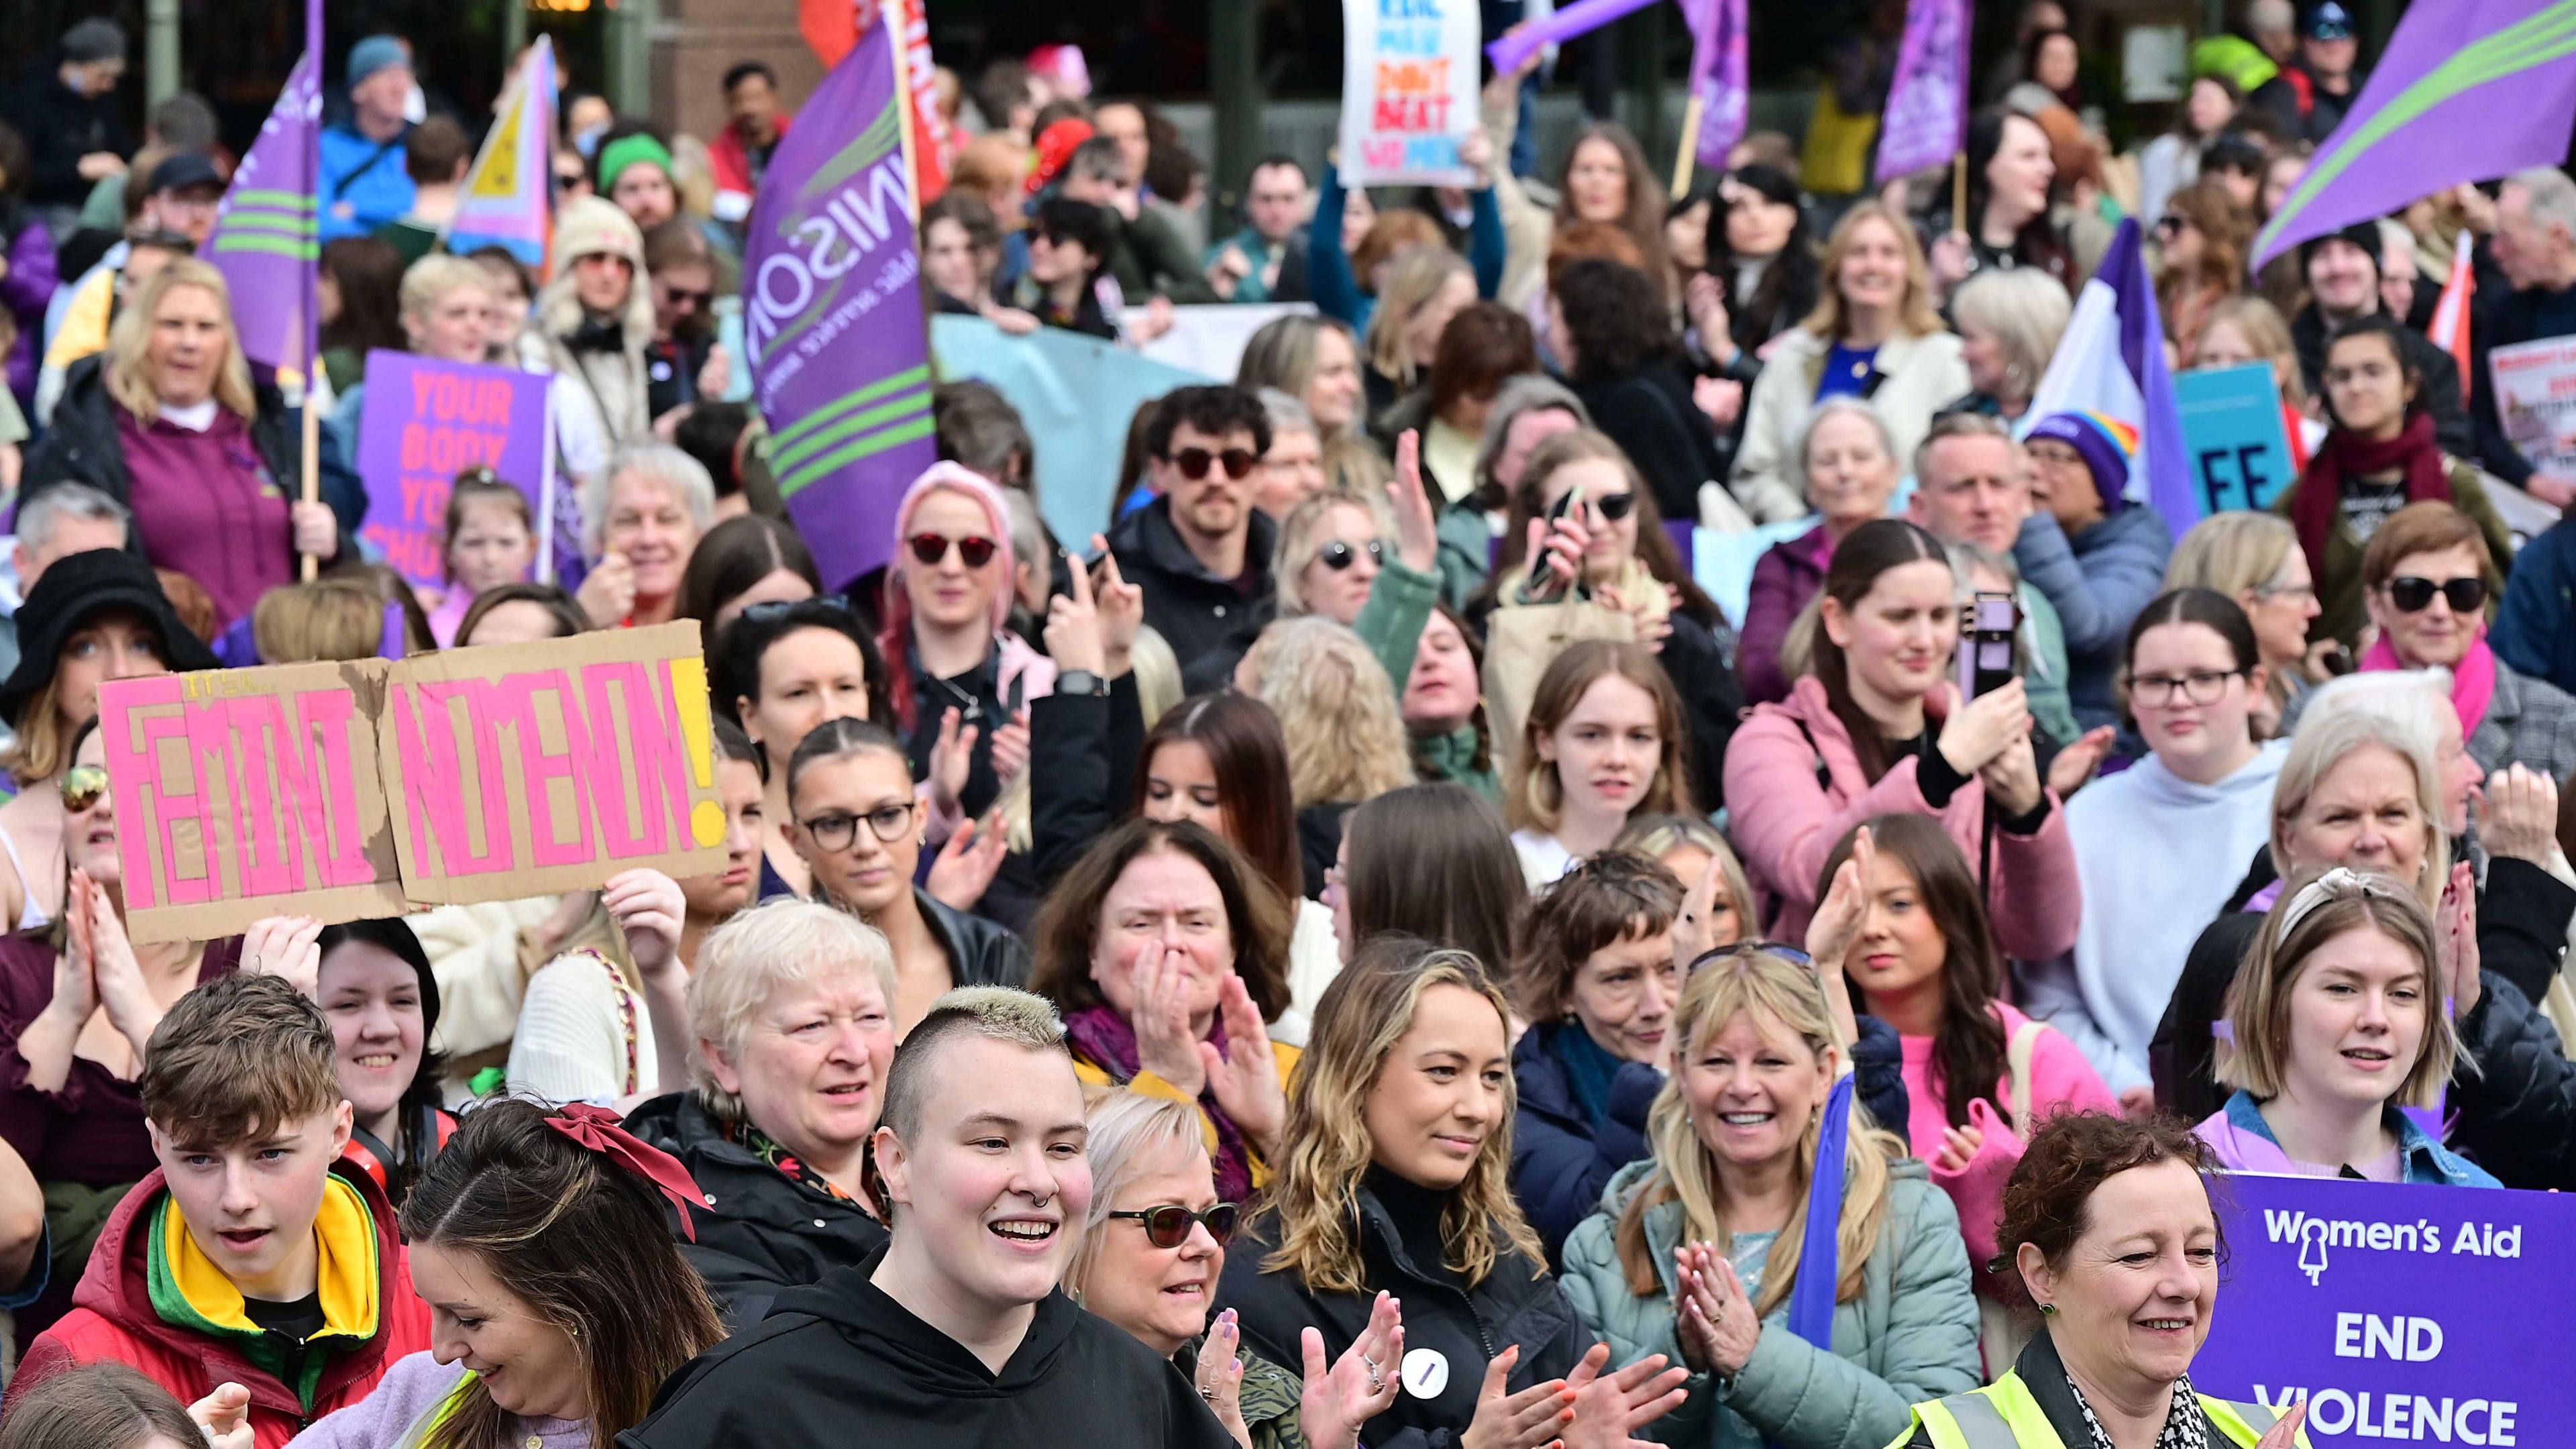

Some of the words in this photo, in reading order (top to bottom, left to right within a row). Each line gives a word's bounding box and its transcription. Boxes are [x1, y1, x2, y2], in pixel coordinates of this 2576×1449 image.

[1373, 97, 1451, 131] BEAT
[412, 370, 513, 427] YOUR
[400, 422, 508, 474] BODY
[401, 477, 451, 527] YO
[99, 675, 376, 909] FEMINI
[391, 657, 727, 879] NOMENON!
[2264, 1209, 2441, 1278] Women's
[2452, 1221, 2522, 1258] Aid
[2334, 1312, 2444, 1362] END
